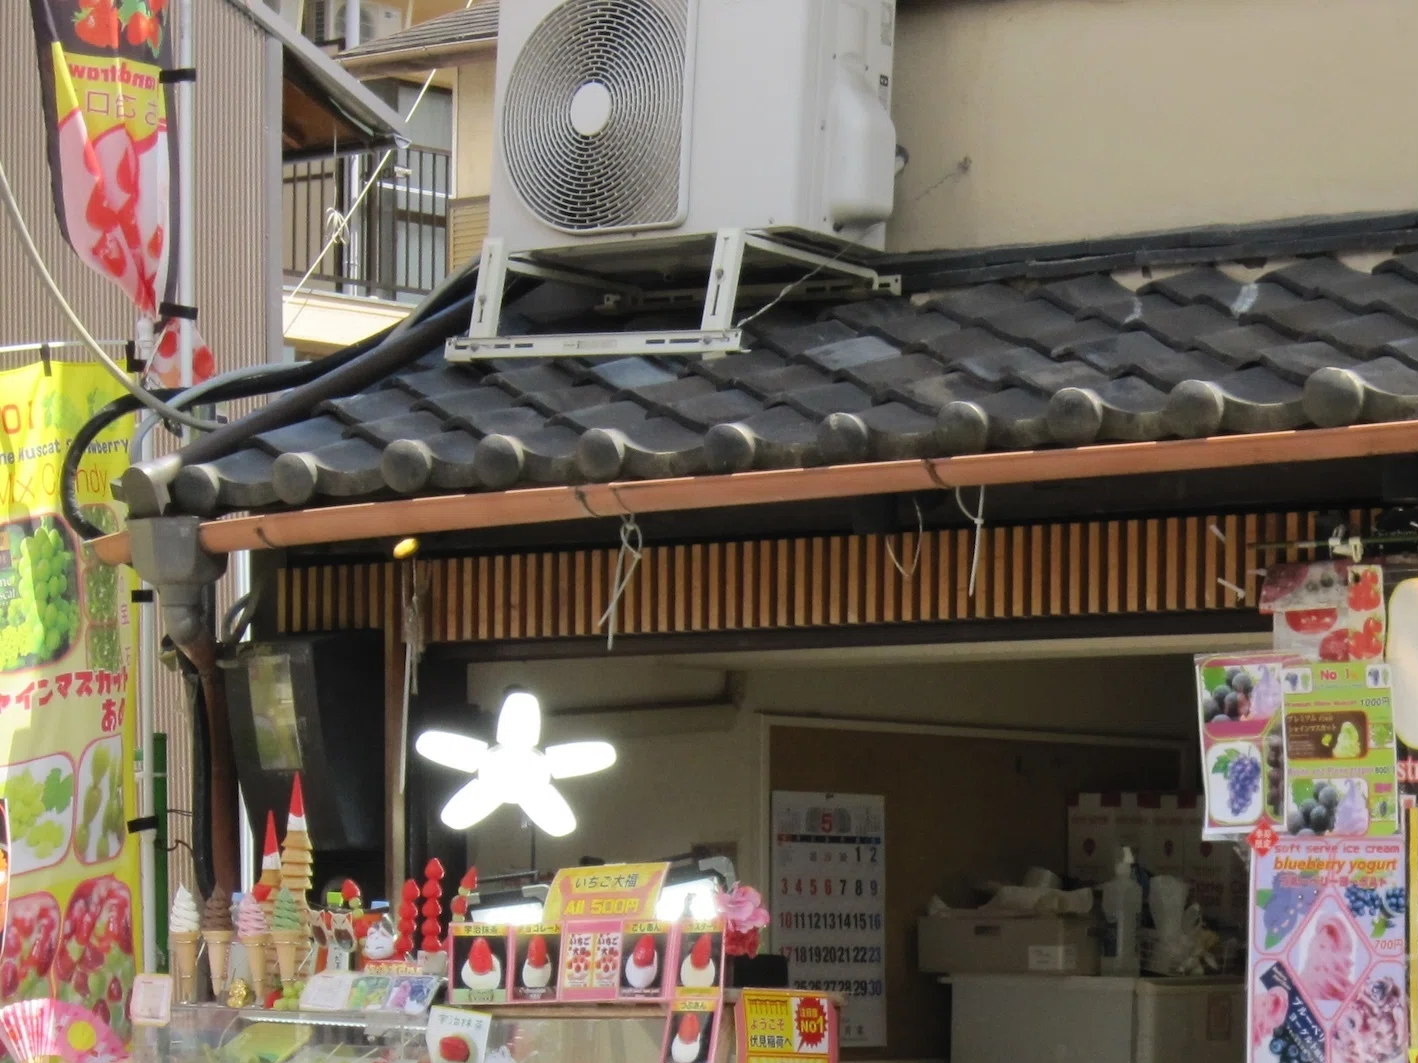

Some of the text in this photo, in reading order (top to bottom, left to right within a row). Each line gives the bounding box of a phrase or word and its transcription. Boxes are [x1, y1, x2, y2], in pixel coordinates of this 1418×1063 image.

[821, 813, 833, 833] 5
[1273, 843, 1401, 854] soft serve ice cream
[1272, 855, 1399, 874] blueberry yogurt
[574, 872, 640, 890] いちご大福
[840, 879, 863, 896] 7 8
[563, 897, 641, 916] All 500円
[630, 922, 662, 934] こしあん
[808, 912, 820, 930] 12
[823, 912, 836, 930] 13
[838, 912, 851, 930] 14
[854, 912, 866, 930] 15
[823, 946, 835, 962] 20
[852, 946, 867, 963] 22
[854, 981, 867, 997] 29
[679, 1000, 707, 1011] つぶあん
[750, 1018, 785, 1031] ようこそ
[800, 1015, 824, 1034] NO1
[749, 1035, 793, 1049] 伏見稲荷へ
